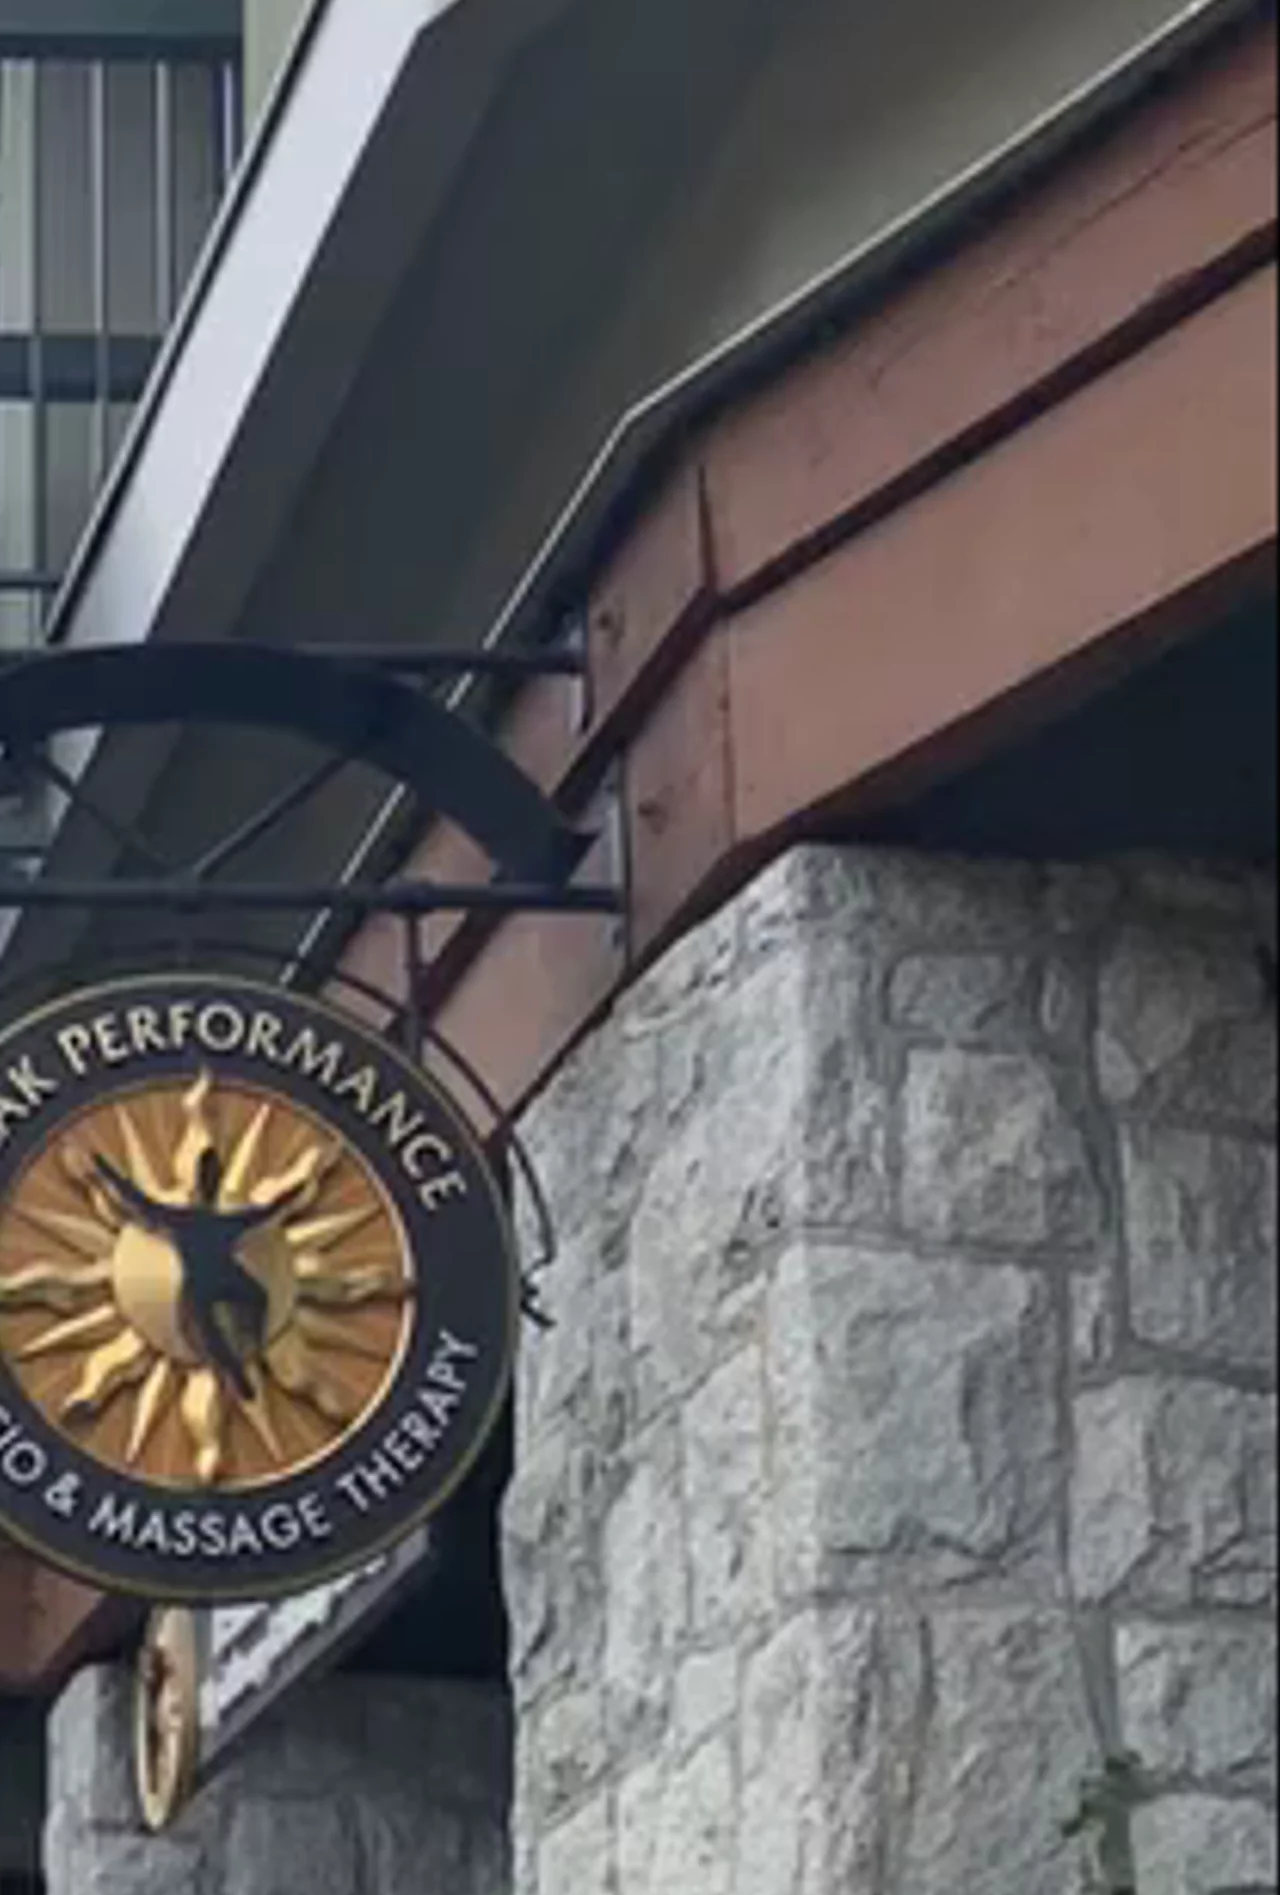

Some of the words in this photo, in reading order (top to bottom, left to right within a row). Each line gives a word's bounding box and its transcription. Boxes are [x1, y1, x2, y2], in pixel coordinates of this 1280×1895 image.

[57, 1001, 467, 1213] PERFORMANCE
[43, 1471, 80, 1516] &
[88, 1495, 333, 1557] MASSAGE
[338, 1329, 480, 1512] THERAPY
